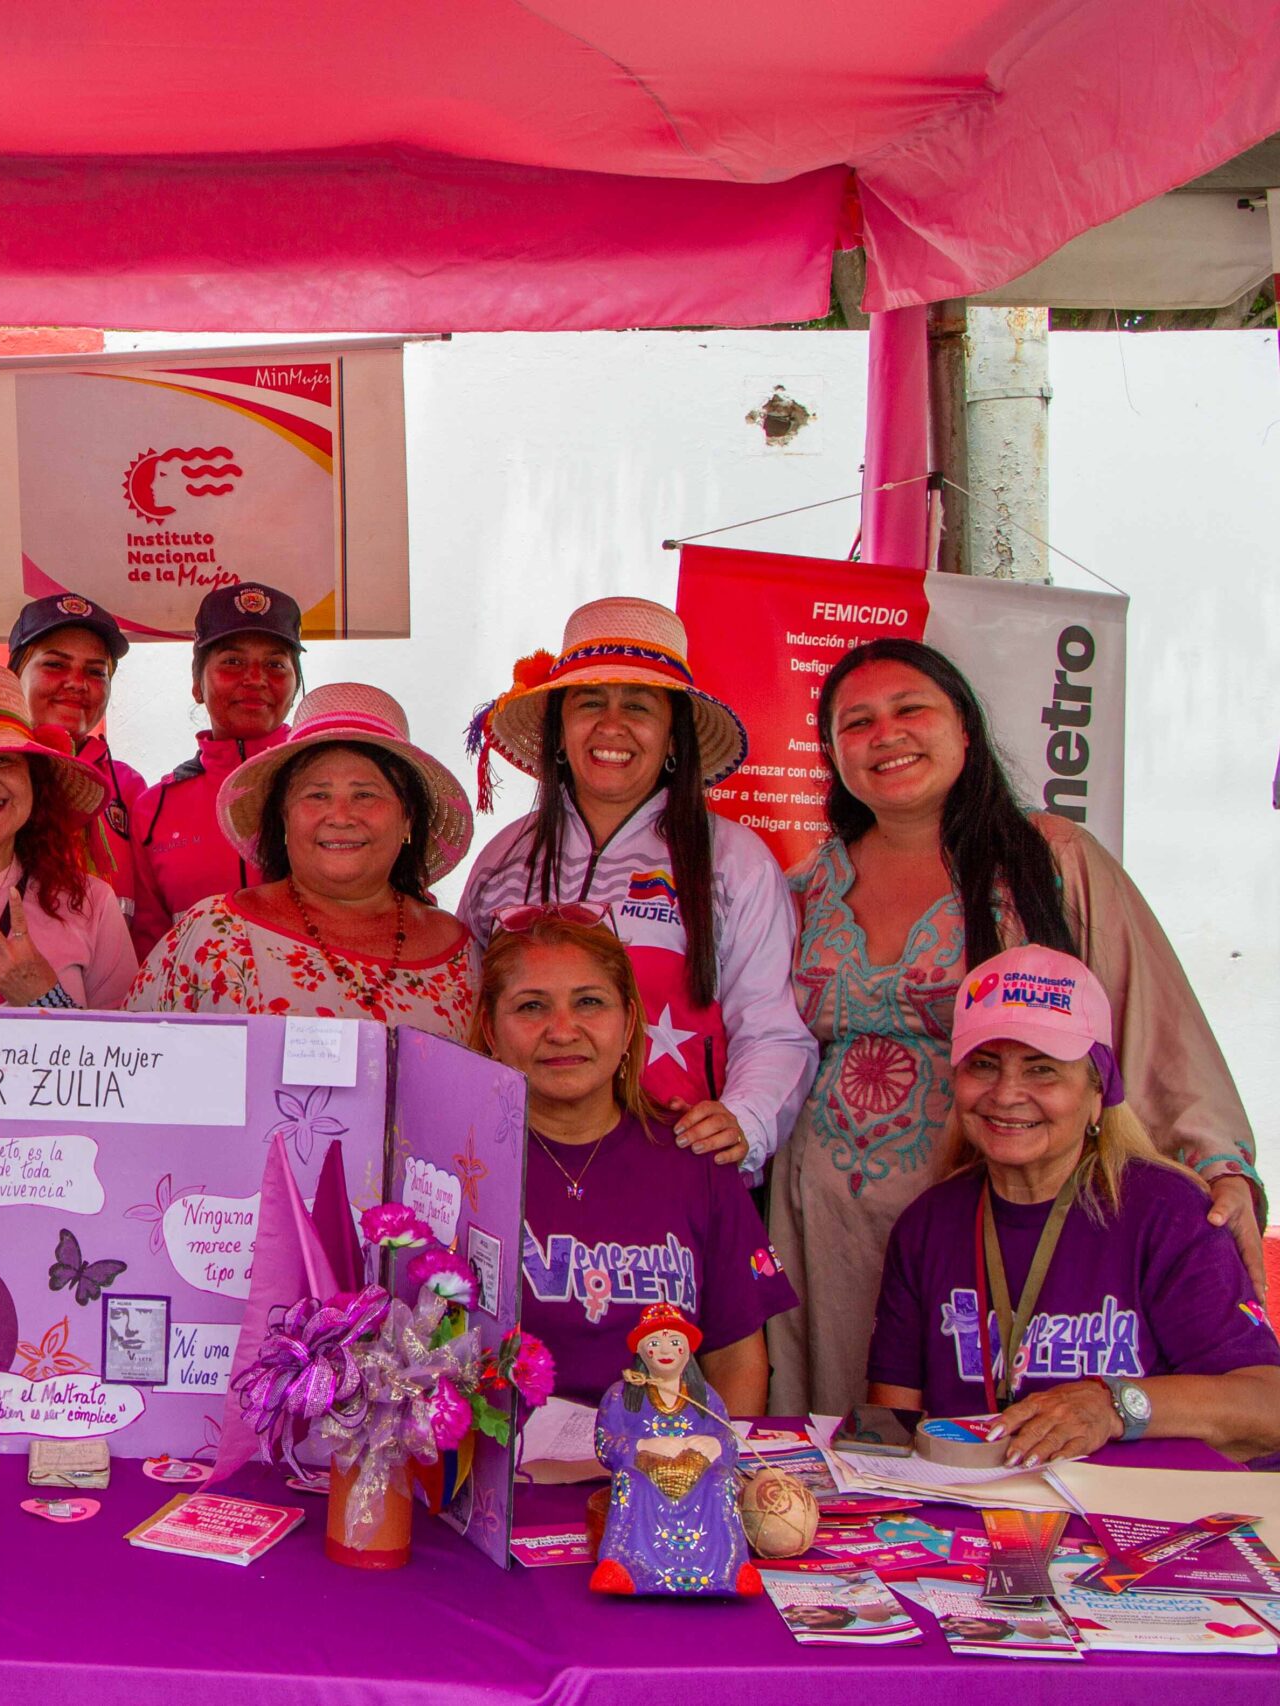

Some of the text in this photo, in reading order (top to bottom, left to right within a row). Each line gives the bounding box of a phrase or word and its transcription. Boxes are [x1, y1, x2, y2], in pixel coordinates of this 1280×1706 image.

[255, 368, 331, 392] MinMujer
[127, 532, 214, 547] Instituto
[127, 549, 216, 565] Nacional
[128, 567, 151, 582] de
[156, 567, 175, 581] la
[178, 563, 240, 592] Mujer
[812, 601, 908, 627] FEMICIDIO
[786, 631, 845, 649] Inducción
[788, 766, 807, 778] con
[740, 791, 749, 801] a
[753, 790, 788, 804] tener
[740, 814, 792, 833] Obligar
[794, 820, 801, 830] a
[620, 904, 681, 926] MUJER
[1004, 972, 1076, 988] GRAN MISIÓN
[1002, 989, 1072, 1011] MUJER
[49, 1044, 72, 1066] de
[79, 1045, 95, 1067] la
[103, 1047, 164, 1076] Mujer
[29, 1069, 126, 1108] ZULIA
[27, 1147, 42, 1160] es
[50, 1140, 63, 1161] la
[20, 1160, 52, 1179] toda
[187, 1241, 242, 1255] merece
[204, 1262, 235, 1288] tipo
[204, 1345, 230, 1359] una
[181, 1360, 218, 1385] Vivas
[20, 1383, 36, 1403] el
[196, 1504, 270, 1521] IGUALDAD DE
[220, 1502, 257, 1513] LEY DE
[182, 1507, 273, 1528] OPORTUNIDADES
[196, 1522, 235, 1532] MUJER
[197, 1516, 244, 1530] PARA LA
[1086, 1601, 1211, 1612] facilitación
